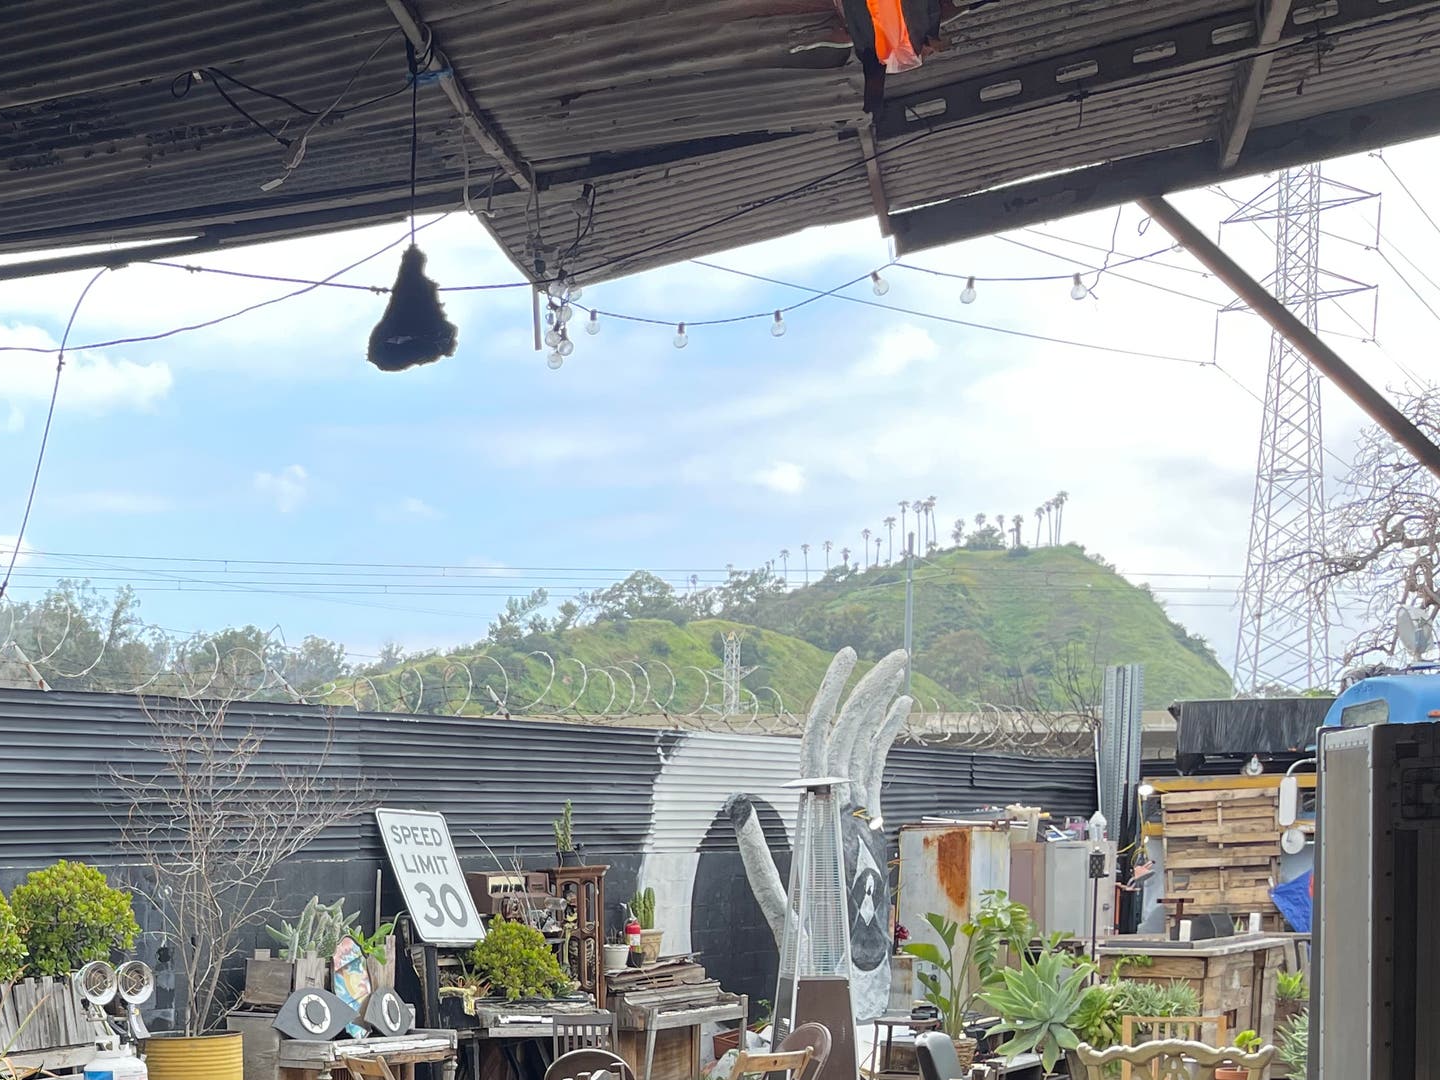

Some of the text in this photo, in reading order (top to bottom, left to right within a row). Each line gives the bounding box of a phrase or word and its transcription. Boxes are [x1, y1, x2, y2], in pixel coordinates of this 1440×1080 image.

[390, 825, 443, 847] SPEED
[400, 854, 449, 875] LIMIT
[414, 882, 468, 928] 30
